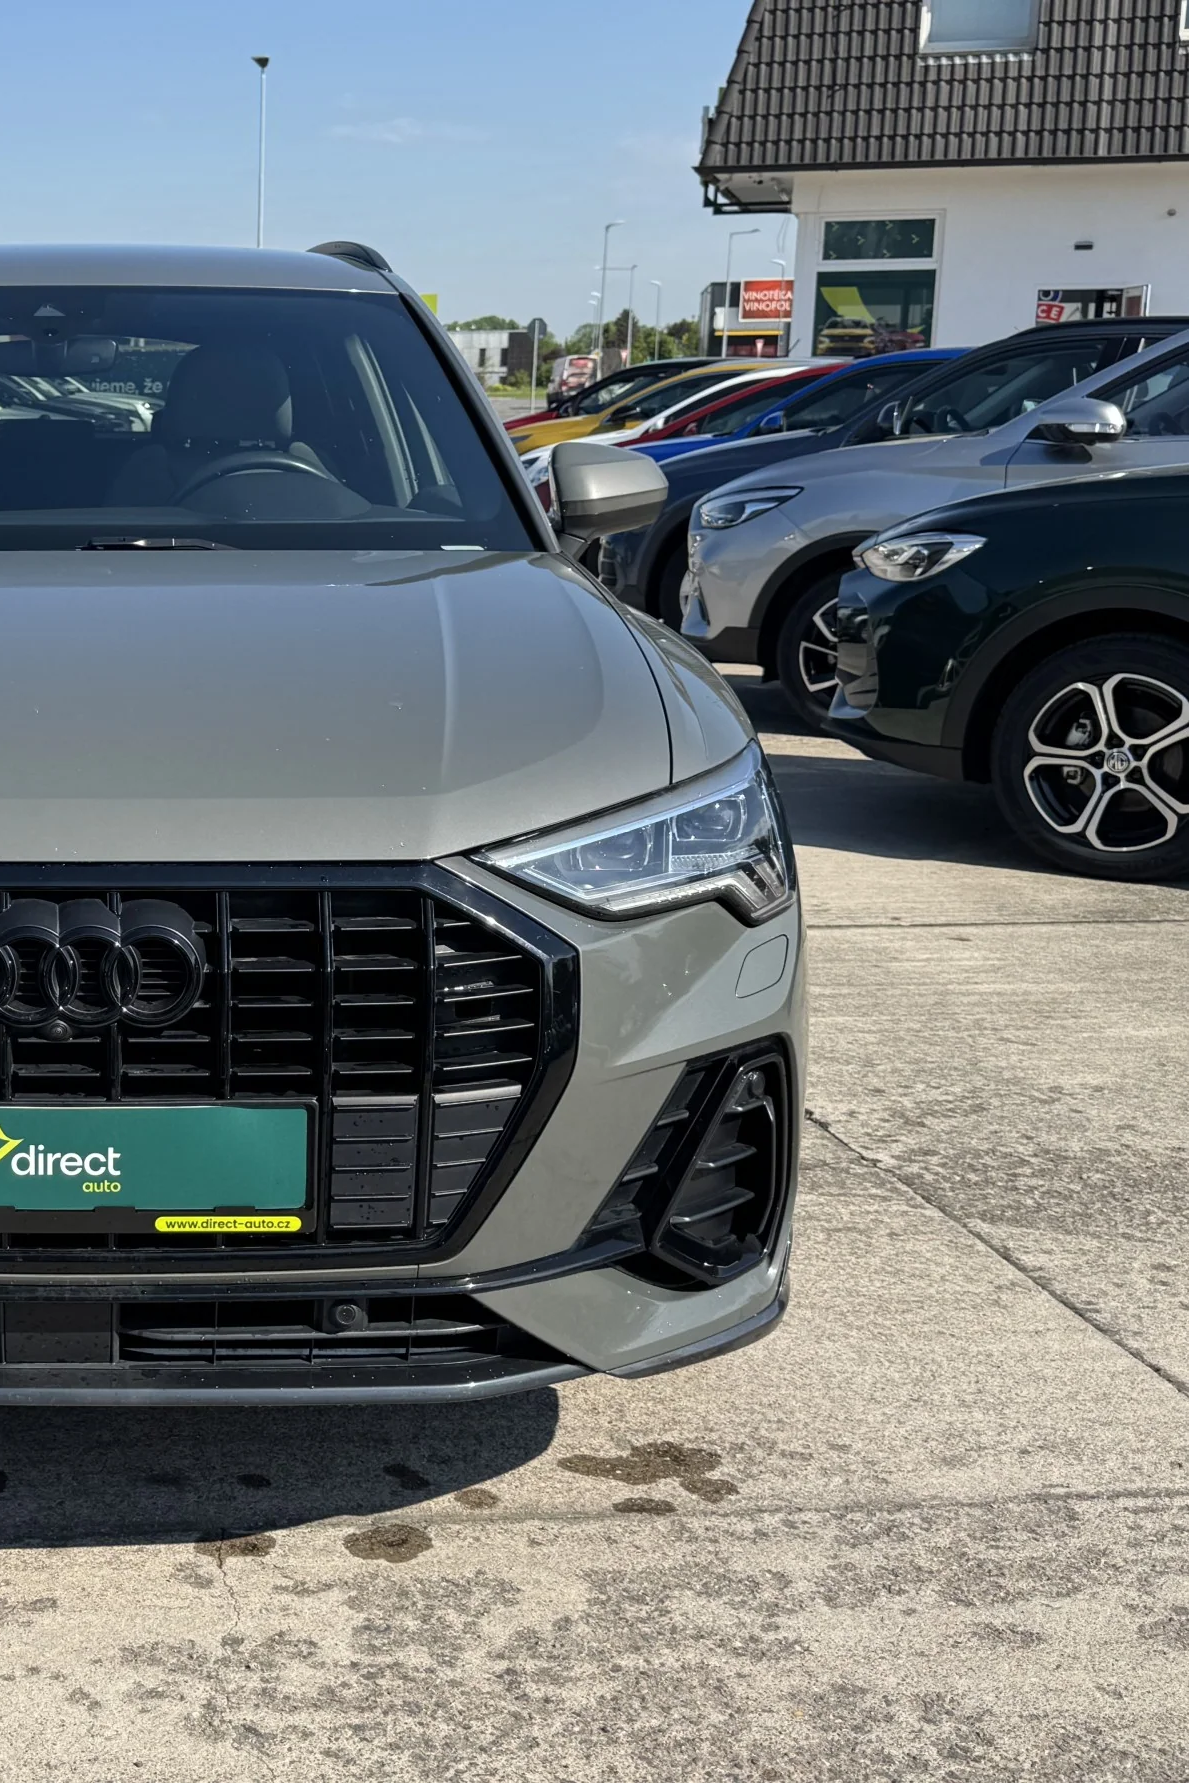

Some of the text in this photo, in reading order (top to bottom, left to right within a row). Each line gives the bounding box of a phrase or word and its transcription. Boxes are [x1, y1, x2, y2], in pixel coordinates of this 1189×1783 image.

[11, 1144, 121, 1176] direct
[82, 1179, 121, 1192] auto
[165, 1218, 291, 1229] www.direct-auto.cz
